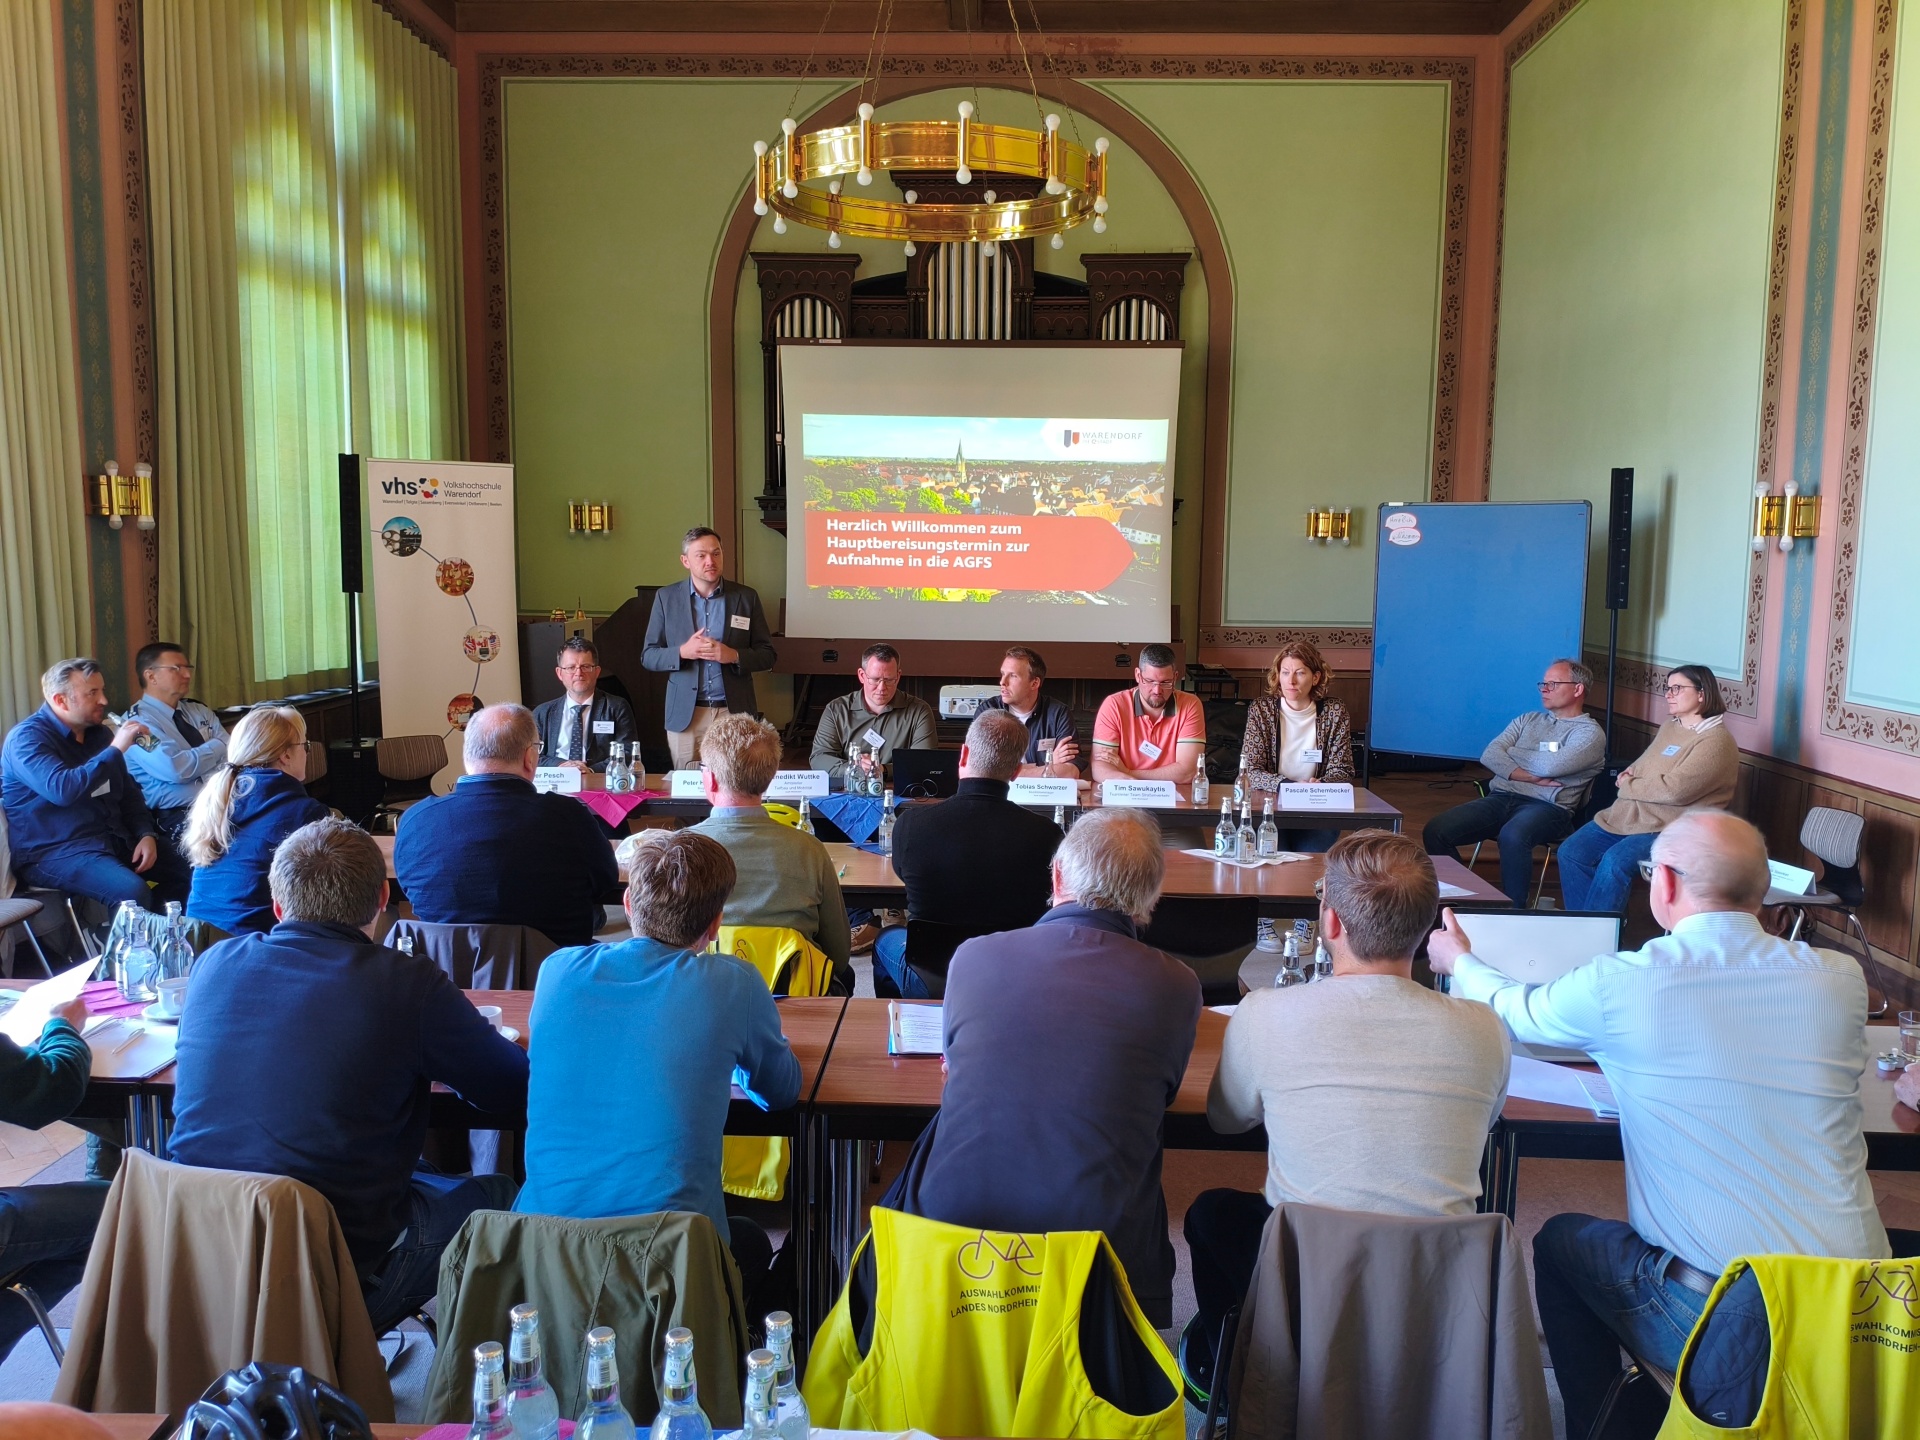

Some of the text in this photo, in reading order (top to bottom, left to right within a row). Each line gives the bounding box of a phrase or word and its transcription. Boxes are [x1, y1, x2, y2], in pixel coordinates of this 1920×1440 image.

[1082, 432, 1143, 440] WARENDORF
[381, 477, 418, 496] vhs
[443, 481, 502, 491] Volkshochschule
[444, 490, 482, 498] Warendorf
[827, 518, 1022, 535] Herzlich Willkommen zum
[827, 536, 1030, 554] Hauptbereisungstermin zur
[827, 553, 993, 569] Aufnahme in die AGFS
[951, 1302, 986, 1318] LANDES
